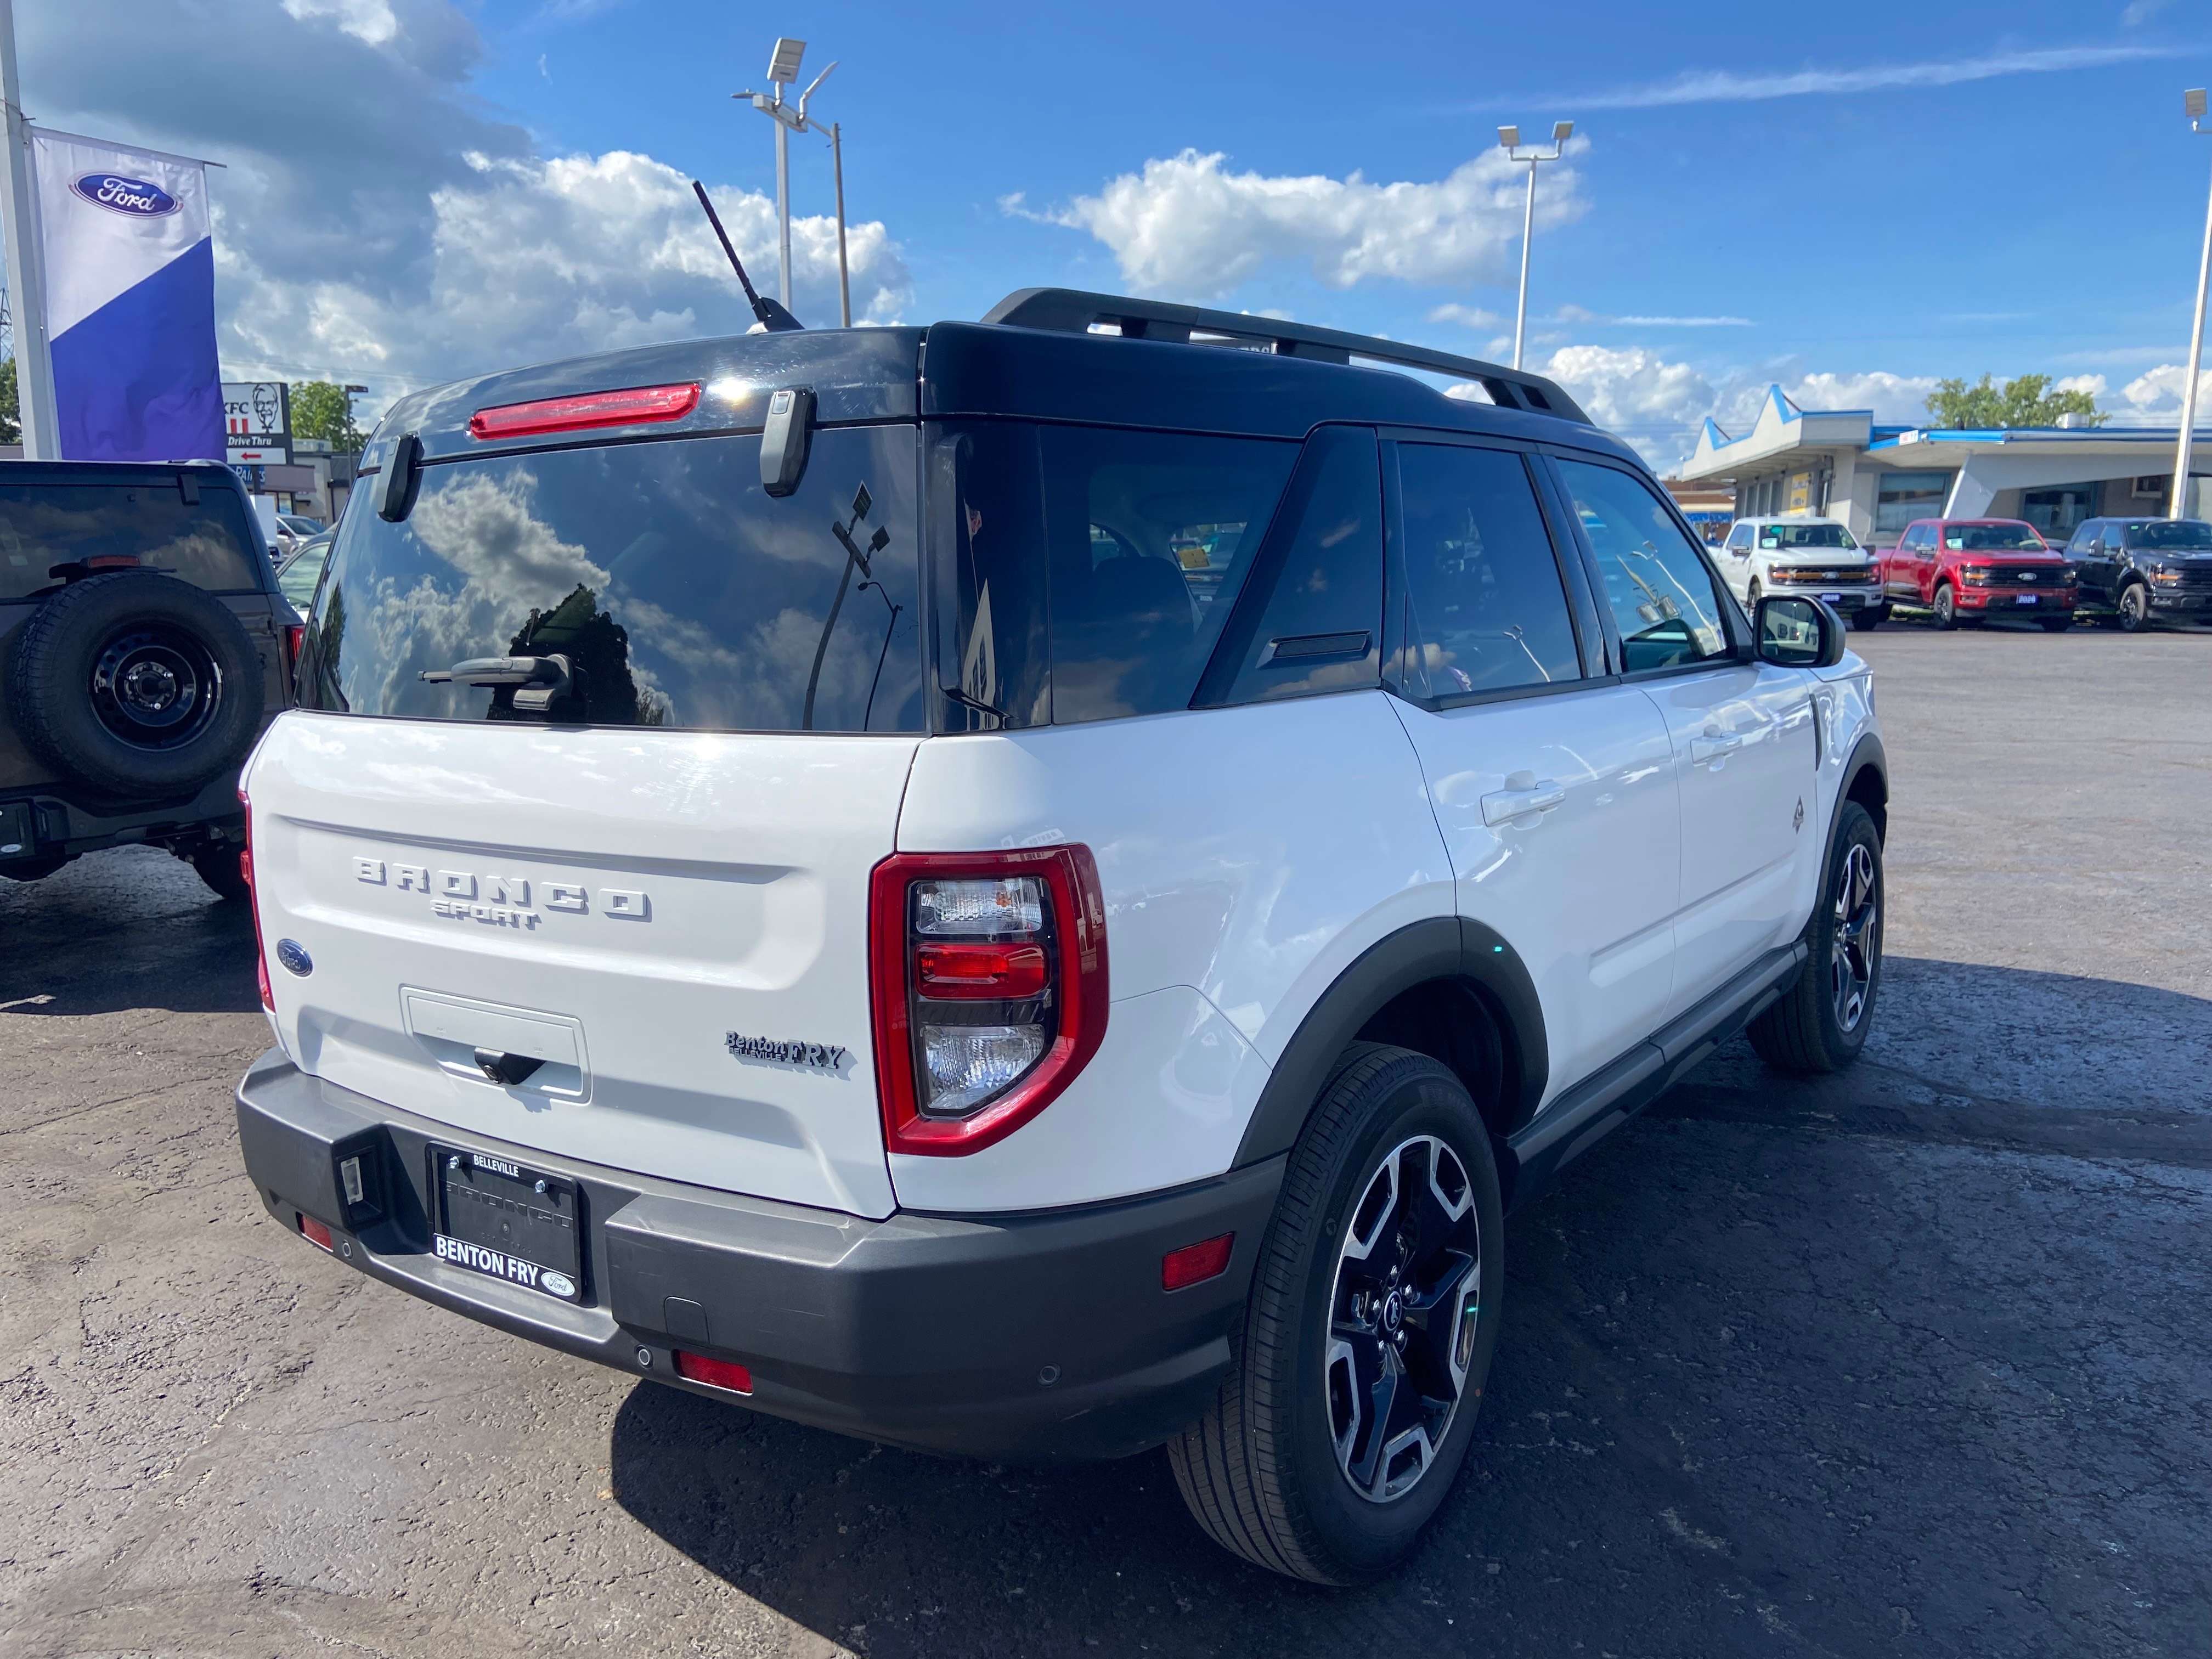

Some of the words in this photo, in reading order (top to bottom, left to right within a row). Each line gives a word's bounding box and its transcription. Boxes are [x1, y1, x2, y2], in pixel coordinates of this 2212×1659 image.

[97, 177, 157, 211] Ford
[228, 436, 251, 446] Drive
[252, 436, 272, 445] Thru
[353, 856, 650, 918] BRONCO
[430, 899, 539, 928] SPORT
[724, 1030, 786, 1054] Benton
[786, 1039, 845, 1069] FRY
[729, 1047, 782, 1062] BELLEVILLE
[473, 1154, 519, 1177] BELLEVILLE
[446, 1180, 573, 1229] BRONCO
[436, 1237, 504, 1276] BENTON
[507, 1258, 539, 1286] FRY
[548, 1274, 567, 1292] Ford
